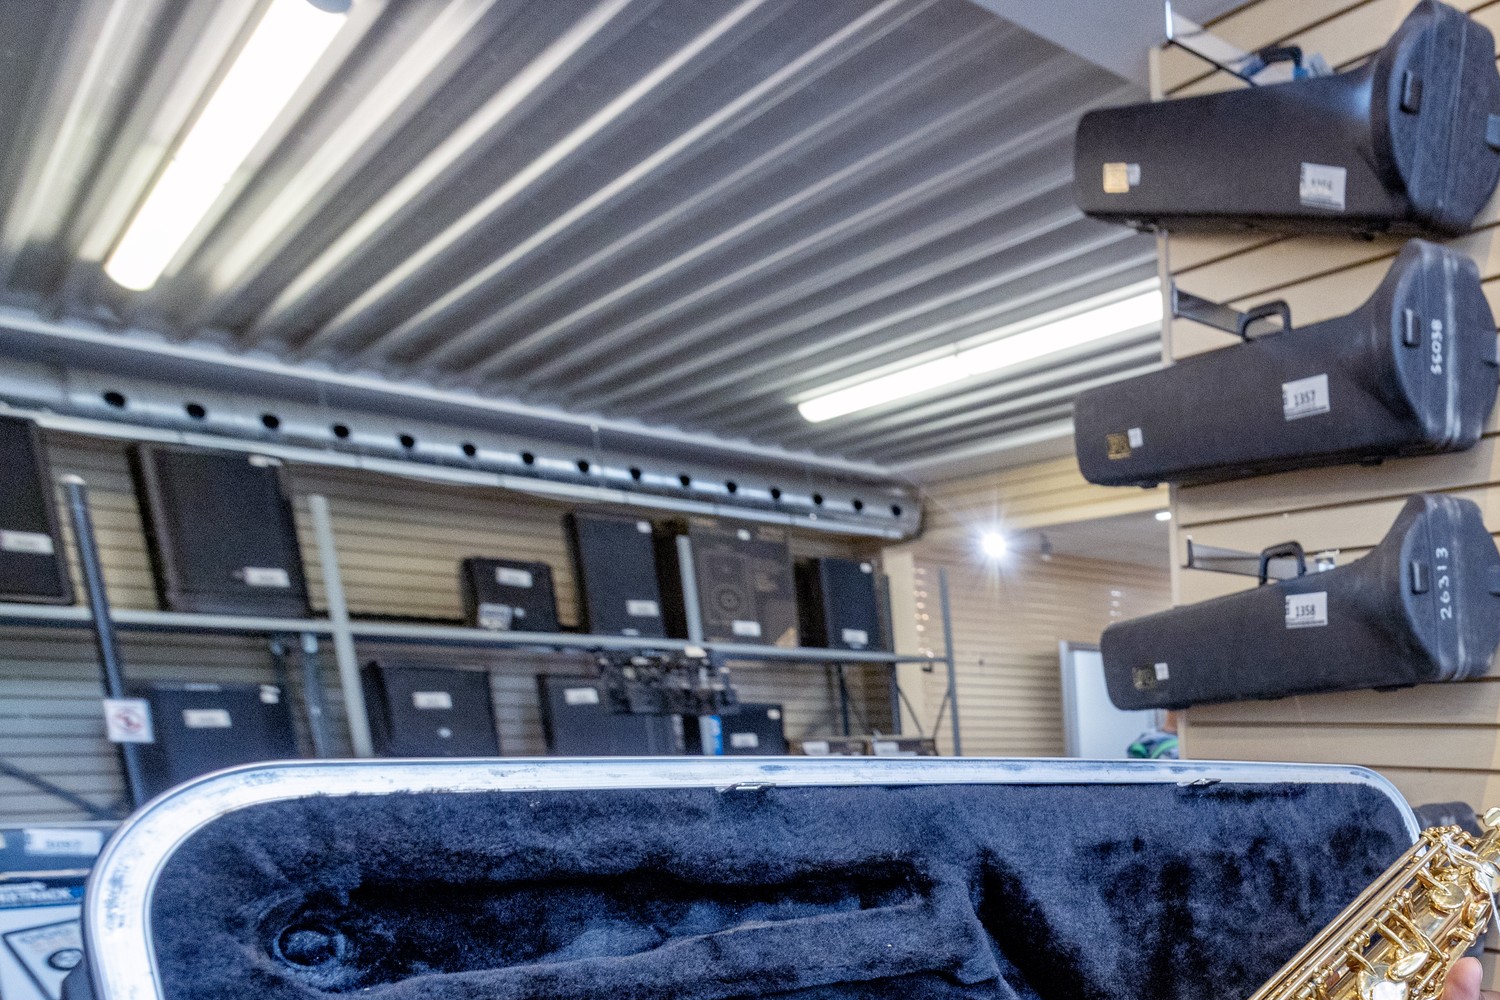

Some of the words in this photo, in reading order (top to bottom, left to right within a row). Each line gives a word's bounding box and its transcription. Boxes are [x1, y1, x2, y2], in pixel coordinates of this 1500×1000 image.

[1293, 389, 1316, 407] 1357
[1436, 547, 1452, 621] 26313
[1295, 604, 1316, 617] 1358
